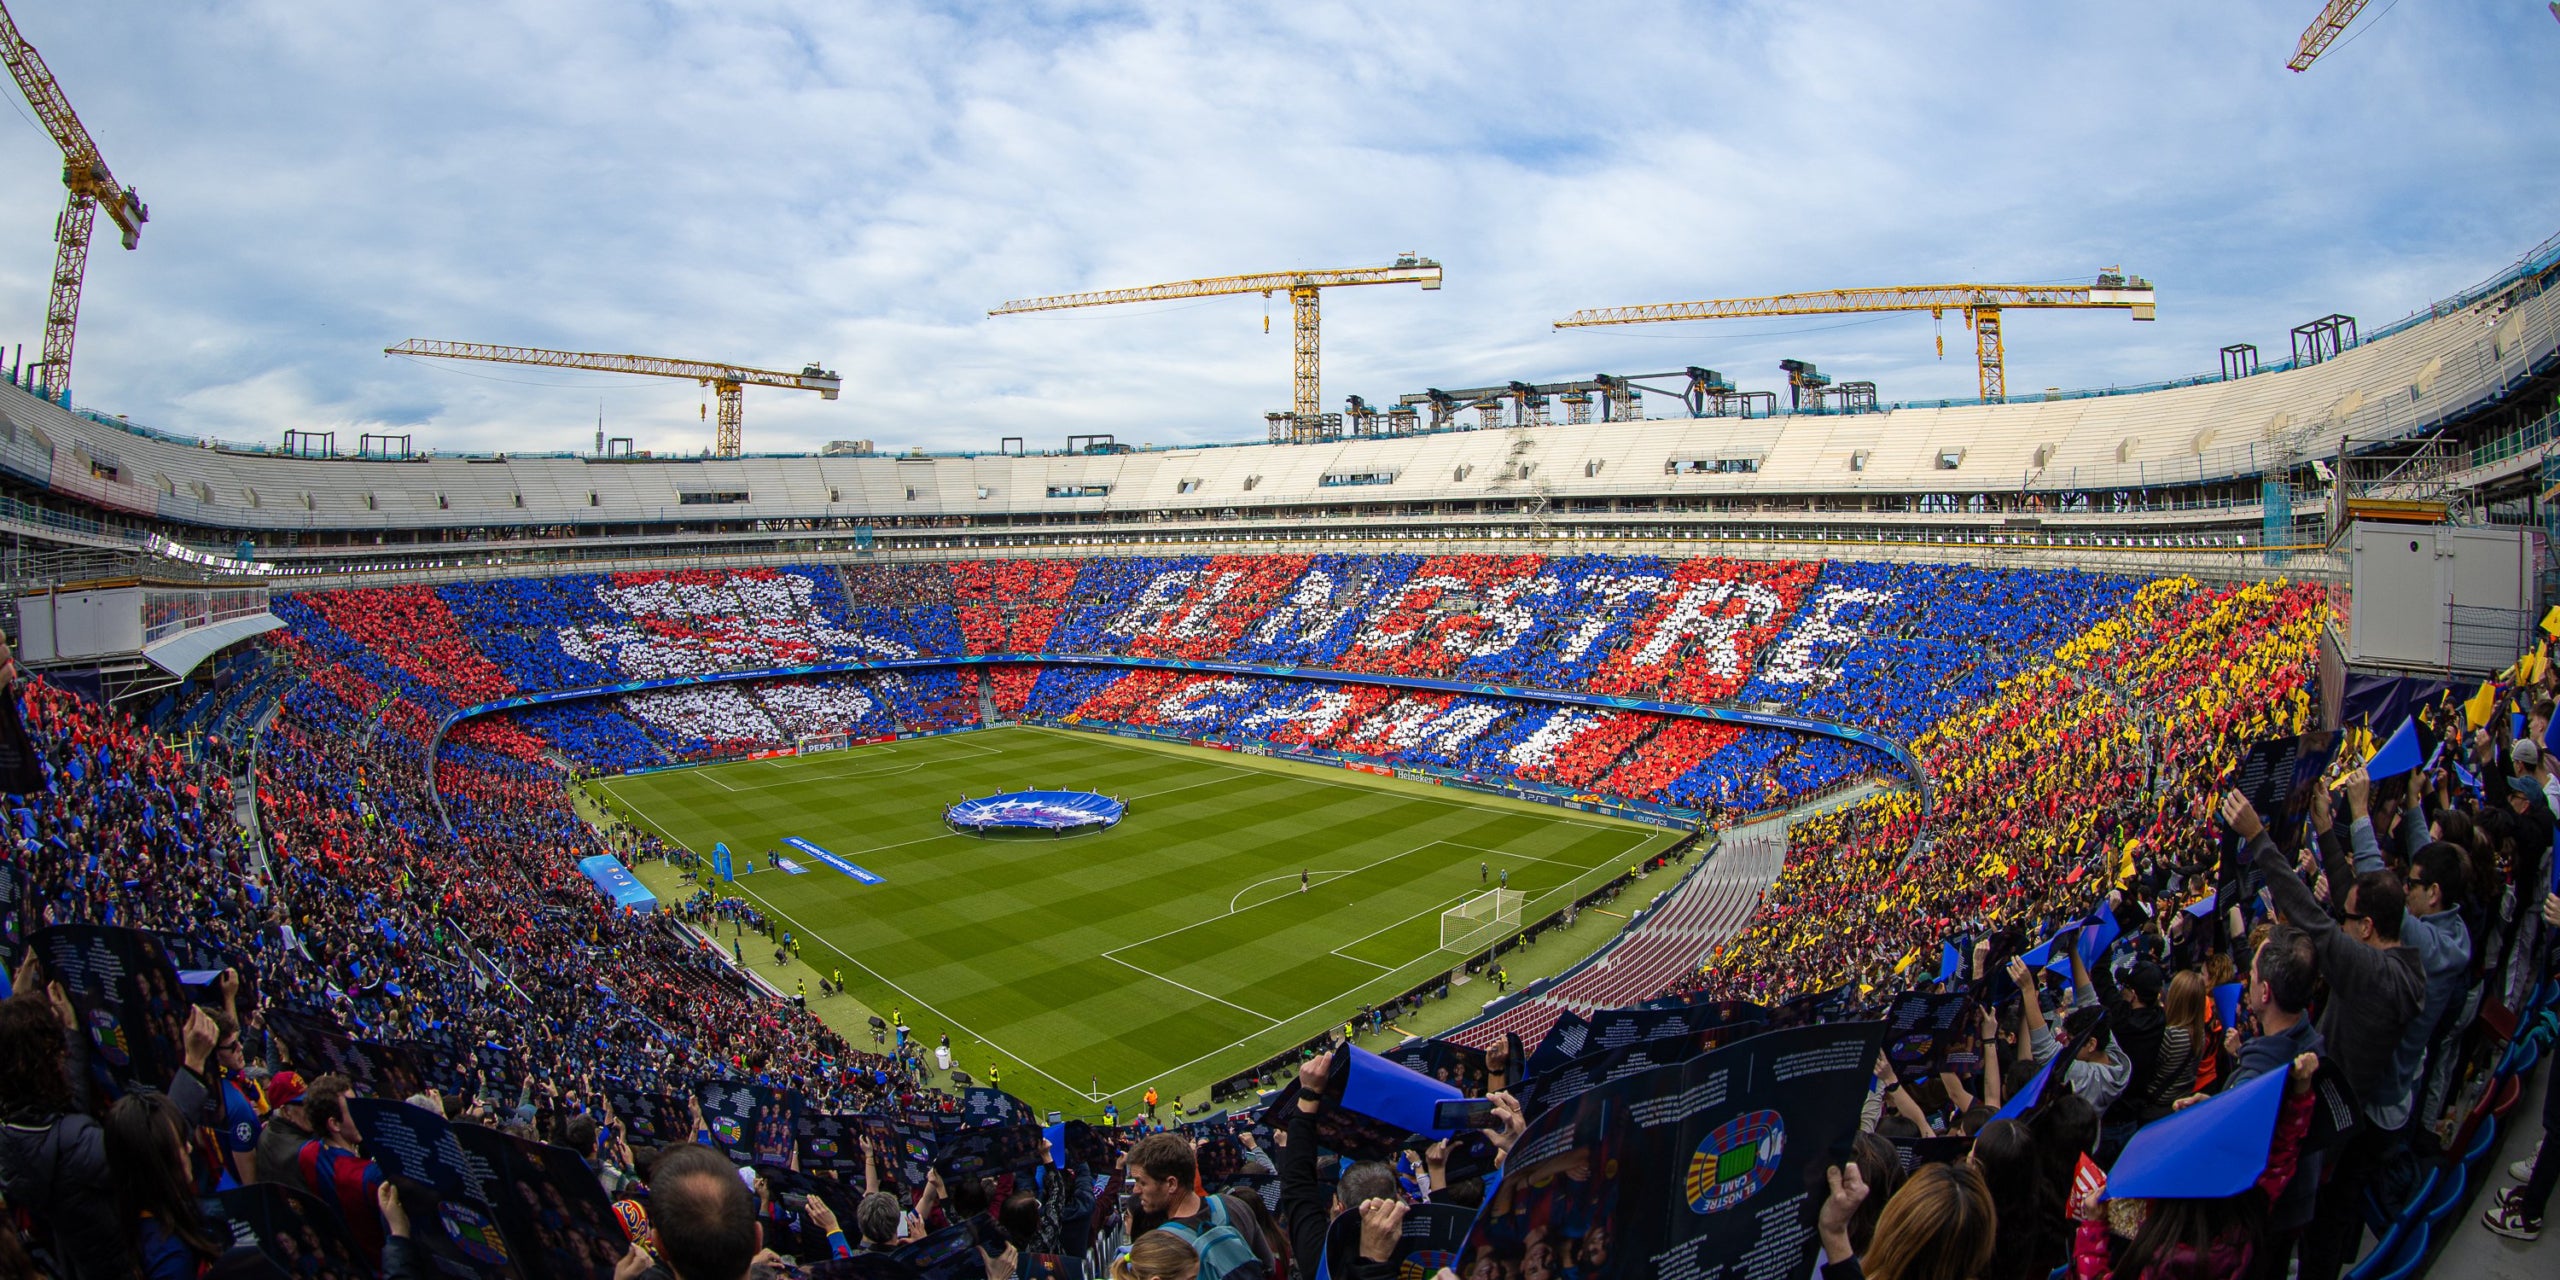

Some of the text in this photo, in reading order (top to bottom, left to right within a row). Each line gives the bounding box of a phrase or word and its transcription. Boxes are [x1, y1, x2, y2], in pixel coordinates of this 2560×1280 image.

[809, 742, 834, 752] PEPSI
[1242, 746, 1266, 756] PEPSI
[1398, 770, 1434, 784] Heineken
[1702, 1182, 1757, 1211] EL NOSTRE
